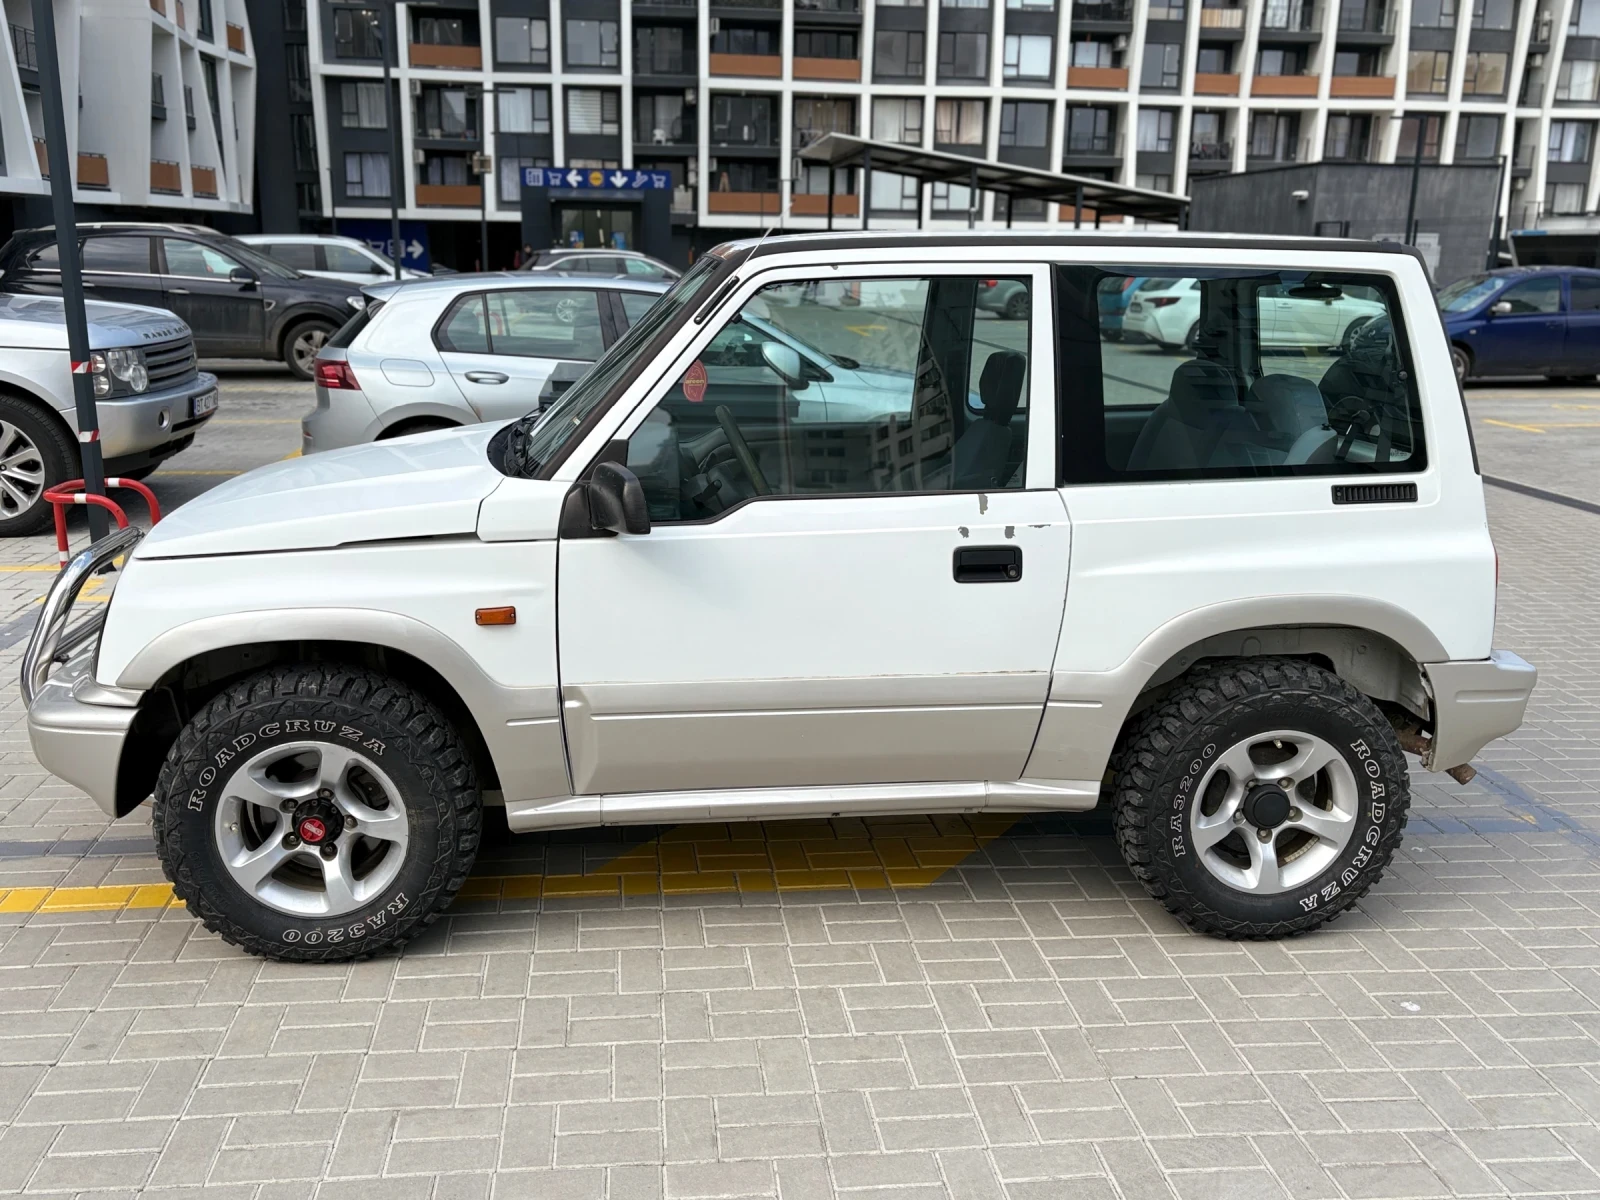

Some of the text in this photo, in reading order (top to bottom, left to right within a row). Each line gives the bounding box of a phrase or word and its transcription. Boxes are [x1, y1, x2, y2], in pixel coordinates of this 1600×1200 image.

[188, 719, 387, 812] ROADCRUZA
[1170, 742, 1217, 857] RA3200
[1299, 739, 1386, 912] ROADCRUZA
[282, 892, 410, 945] RA3200
